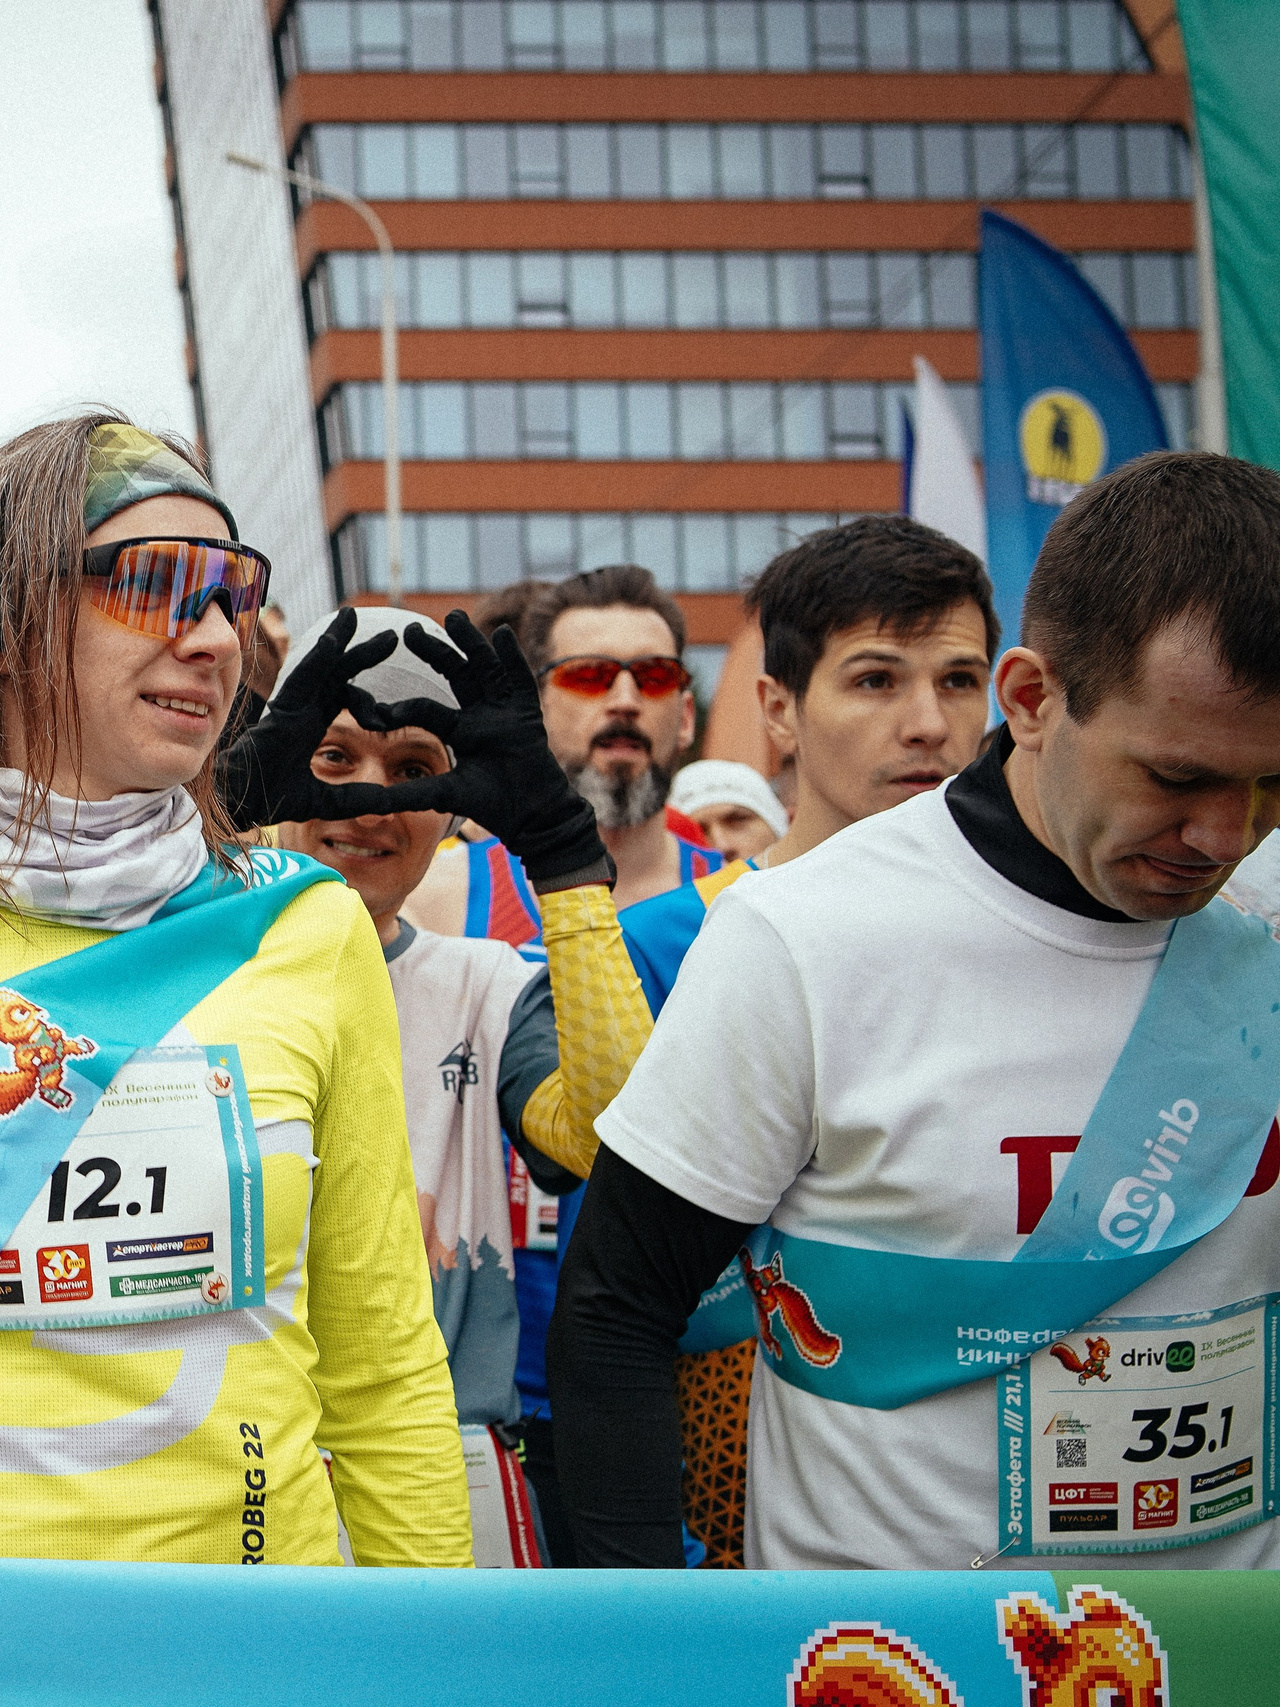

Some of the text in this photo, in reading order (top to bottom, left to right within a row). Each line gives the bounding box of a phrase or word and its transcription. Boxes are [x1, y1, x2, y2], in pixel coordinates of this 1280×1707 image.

[48, 1156, 167, 1222] 12.1
[42, 1249, 81, 1281] 30
[1120, 1343, 1195, 1368] drivee
[239, 1422, 264, 1459] 22
[1122, 1401, 1234, 1463] 35.1
[1006, 1436, 1026, 1535] Эстафета
[1055, 1488, 1087, 1501] ЦФТ
[1138, 1483, 1170, 1510] 30
[1147, 1509, 1174, 1519] МАГНИТ
